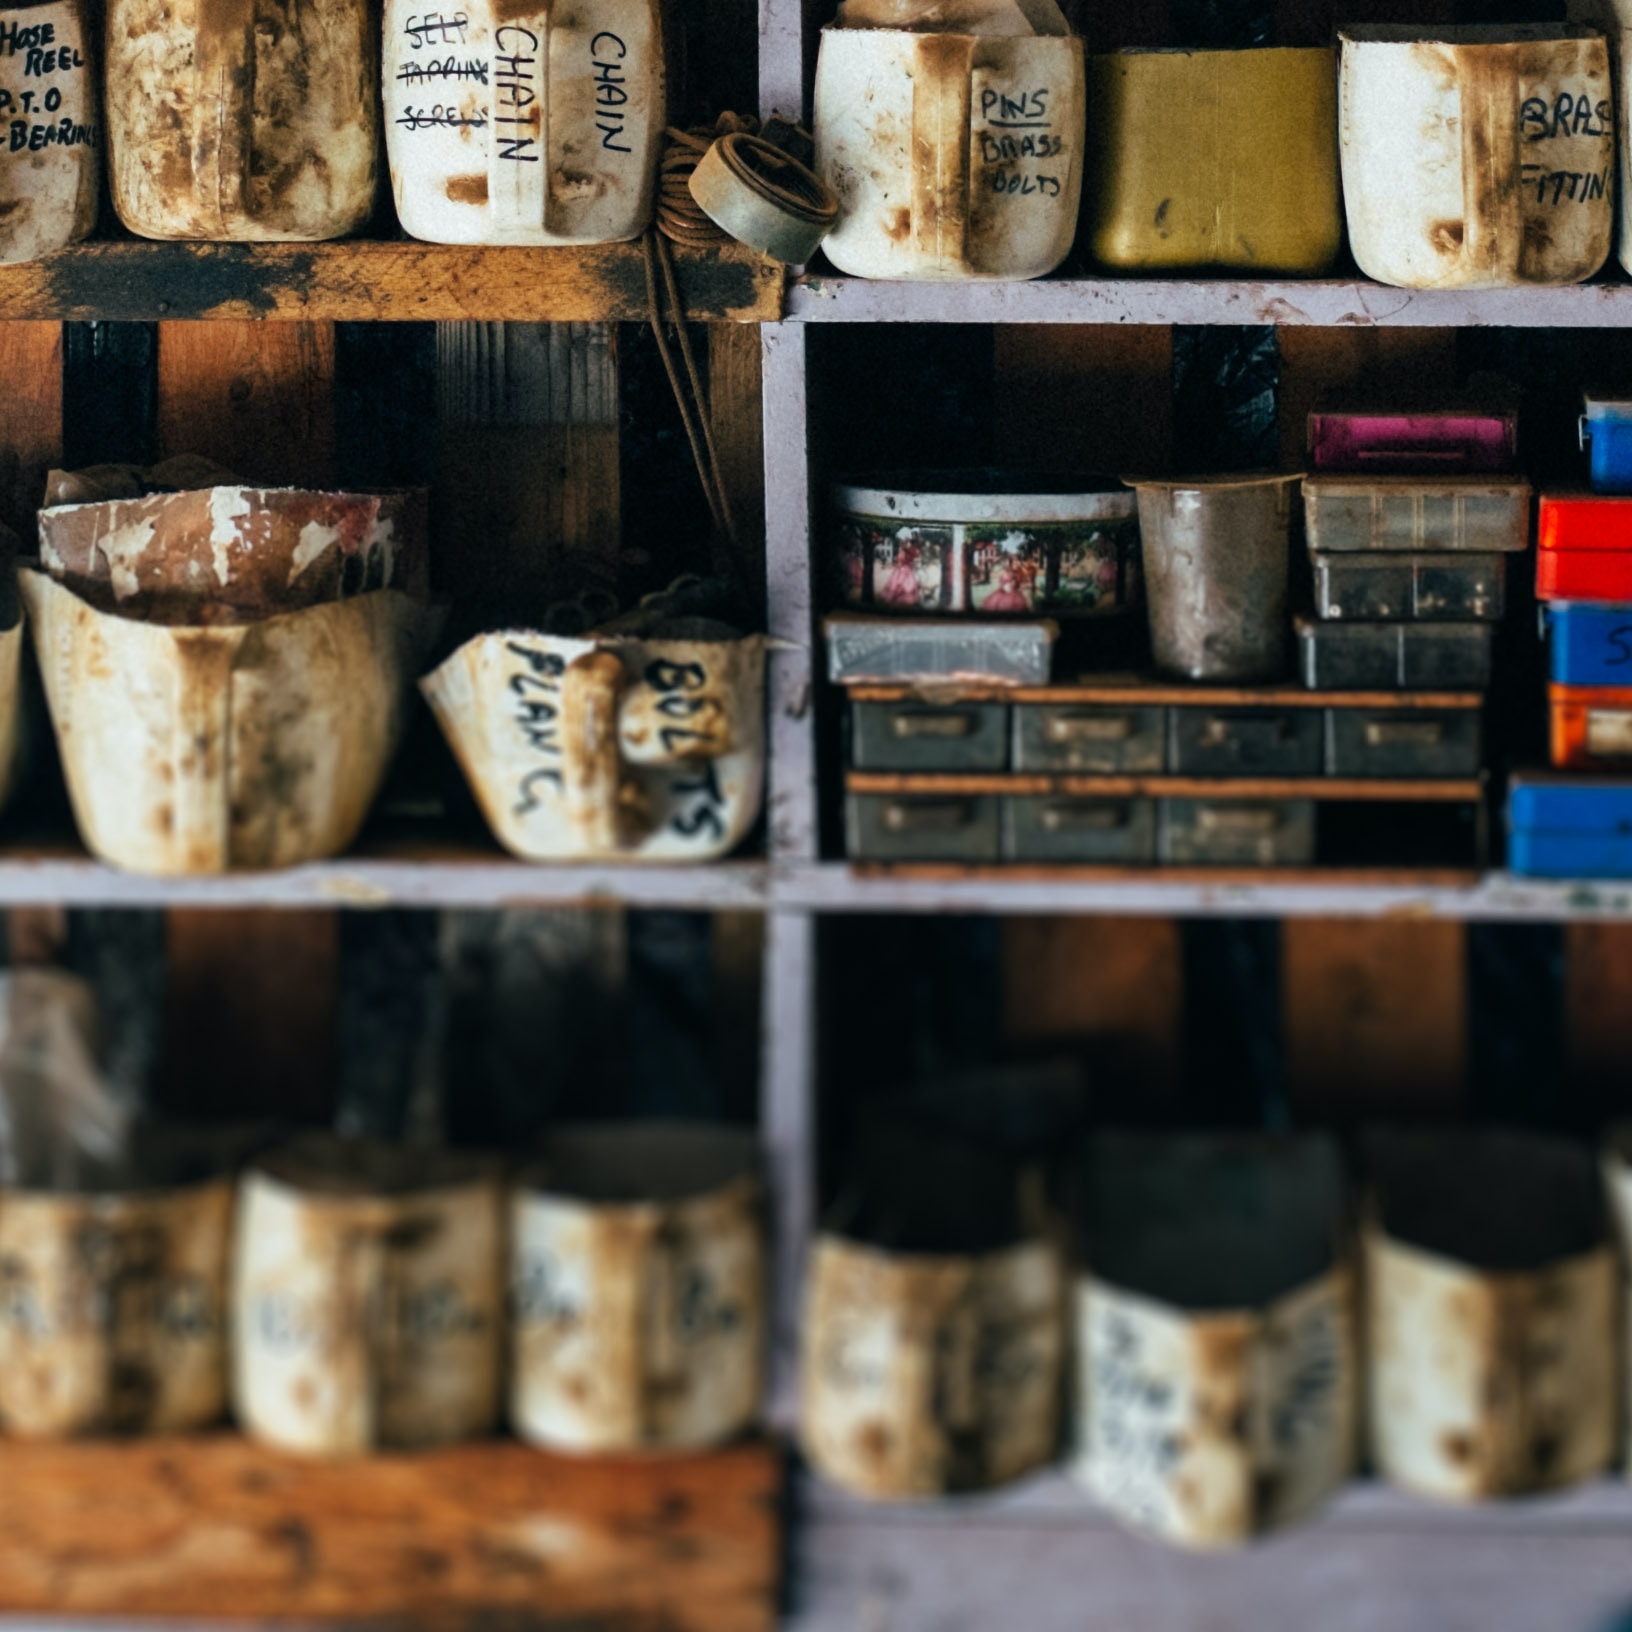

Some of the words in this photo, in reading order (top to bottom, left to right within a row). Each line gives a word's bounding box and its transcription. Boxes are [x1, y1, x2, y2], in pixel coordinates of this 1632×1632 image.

[24, 45, 86, 77] REEL
[493, 25, 540, 162] CHAIN
[589, 31, 632, 154] CHAIN
[980, 88, 1051, 120] PINS
[979, 134, 1062, 165] BRASS
[993, 174, 1060, 198] BOLTS
[642, 657, 727, 842] BOLTS
